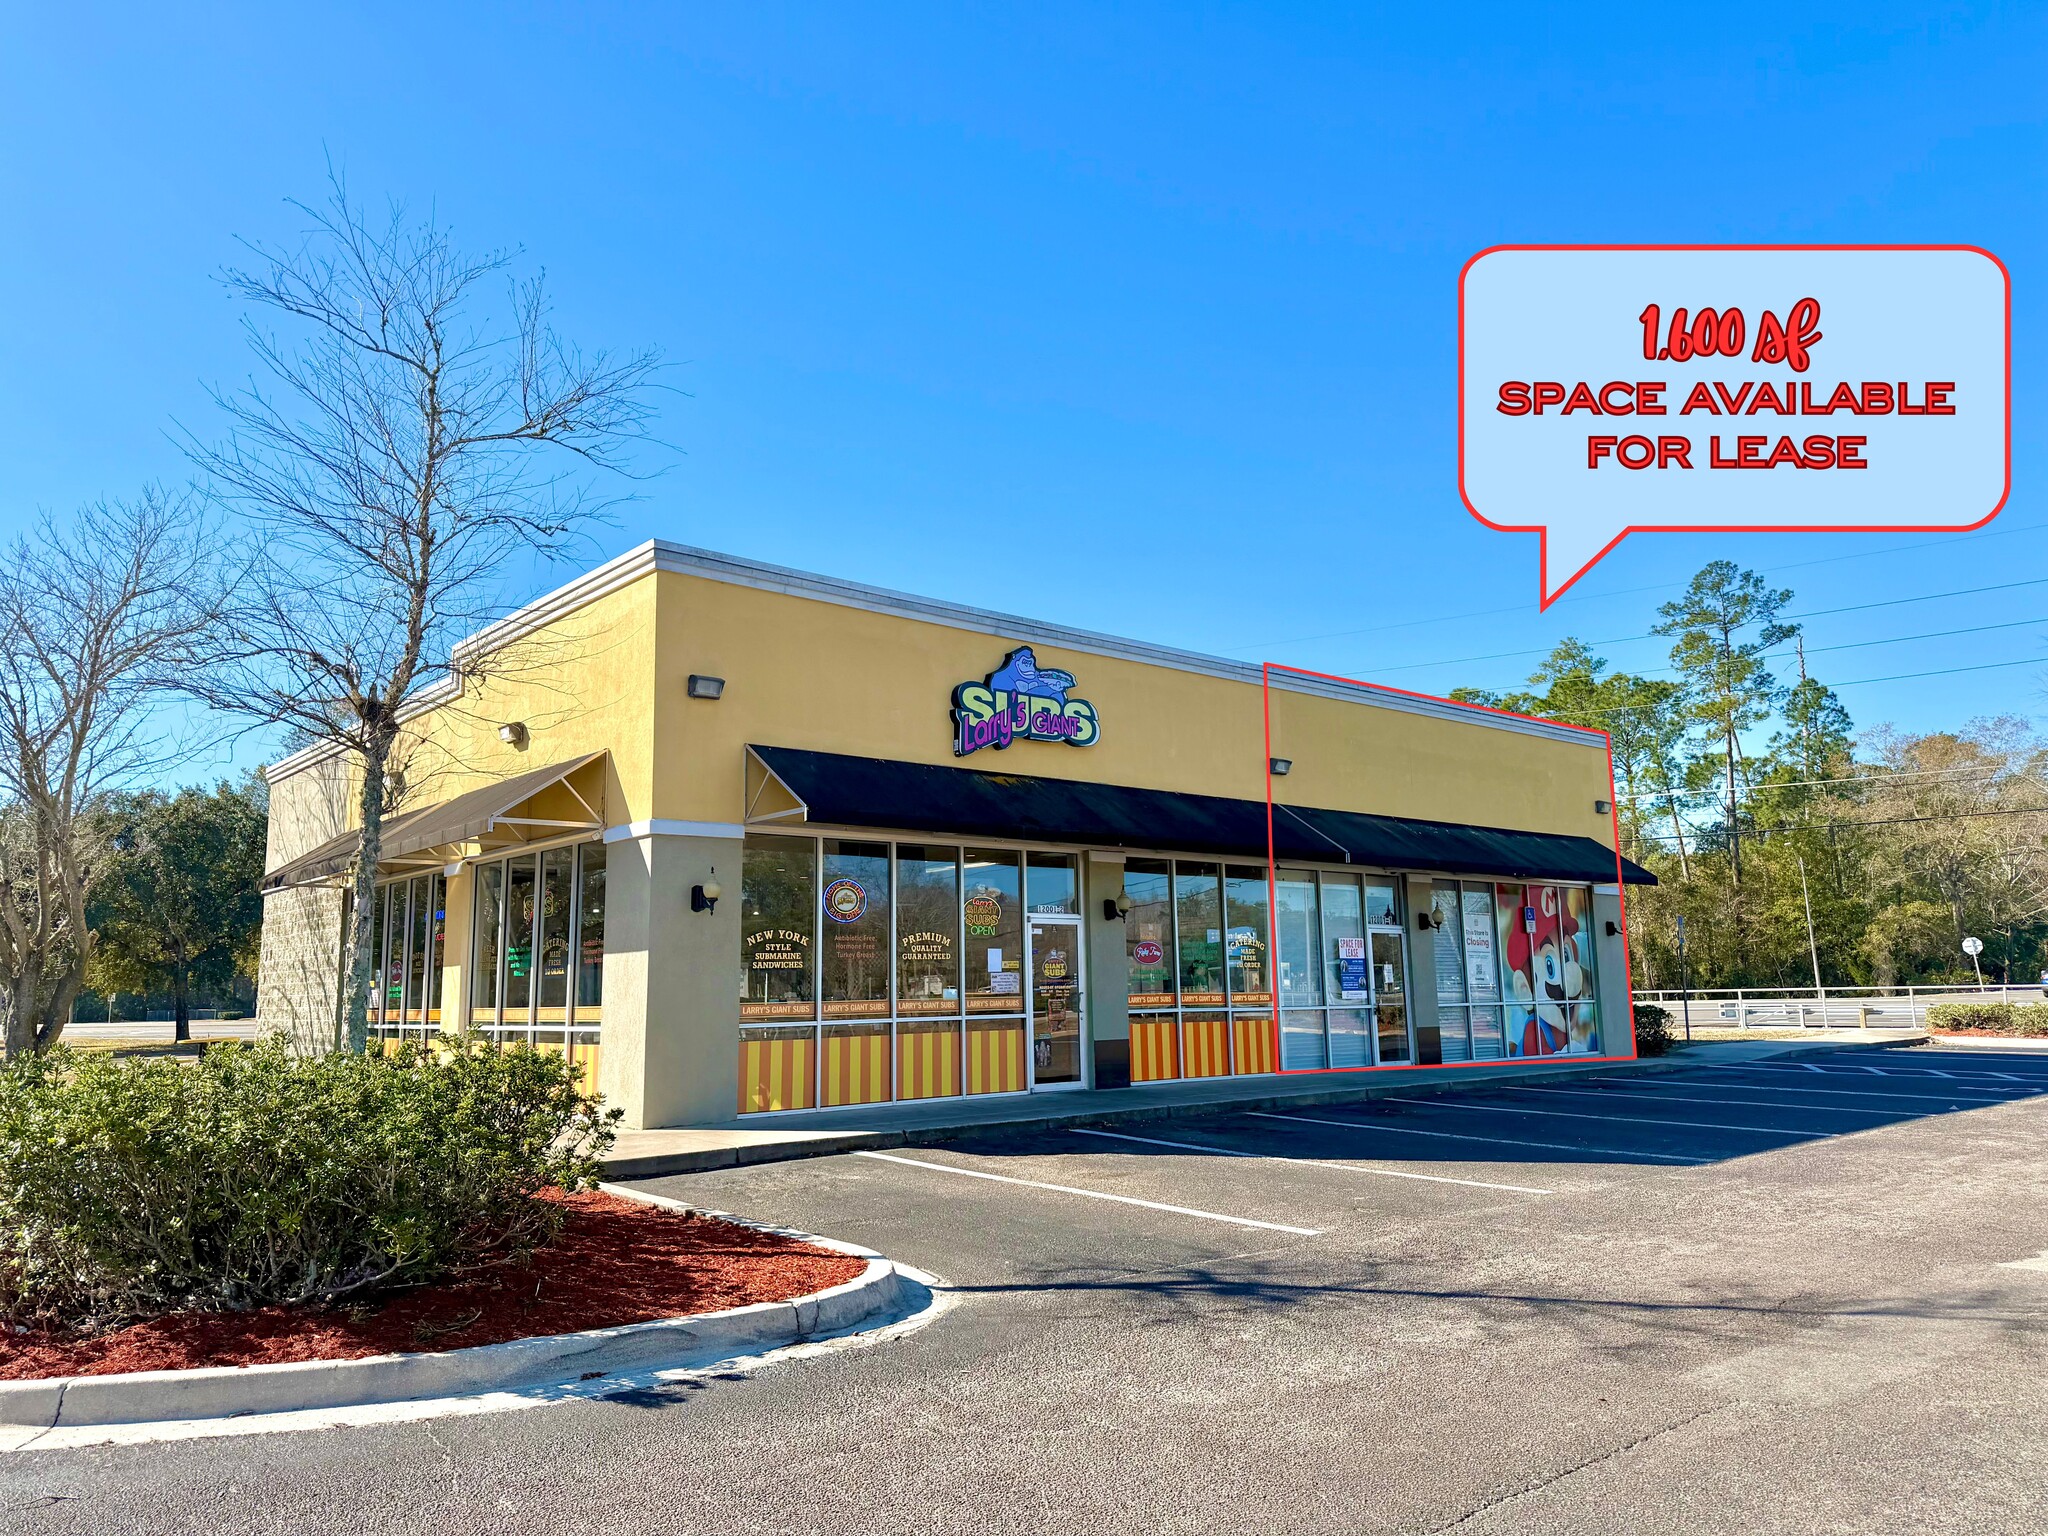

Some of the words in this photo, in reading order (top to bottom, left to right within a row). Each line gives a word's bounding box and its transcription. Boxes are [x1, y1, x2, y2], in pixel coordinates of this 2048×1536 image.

[964, 691, 1026, 751] Larry's
[1032, 711, 1080, 737] GIANT
[966, 906, 998, 914] GIANT
[966, 914, 999, 925] SUBS
[971, 926, 996, 936] OPEN
[746, 929, 774, 947] NEW
[778, 929, 810, 947] YORK
[902, 932, 951, 947] PREMIUM
[1467, 937, 1490, 949] Closing
[765, 943, 792, 951] STYLE
[1230, 938, 1265, 951] CATERING
[1340, 939, 1353, 949] SPACE
[1354, 939, 1363, 949] FOR
[755, 952, 802, 960] SUBMARINE
[837, 951, 855, 959] Turkey
[1346, 949, 1359, 958] LEASE
[752, 961, 803, 969] SANDWICHES
[1045, 969, 1066, 977] SUBS
[823, 1004, 849, 1012] LARRY'S
[850, 1003, 868, 1011] GIANT
[869, 1002, 885, 1010] SUBS
[967, 1000, 988, 1008] LARRY'S
[1006, 999, 1019, 1007] SUBS
[742, 1006, 770, 1015] LARRY'S
[771, 1005, 791, 1014] GIANT
[792, 1005, 810, 1013] SUBS
